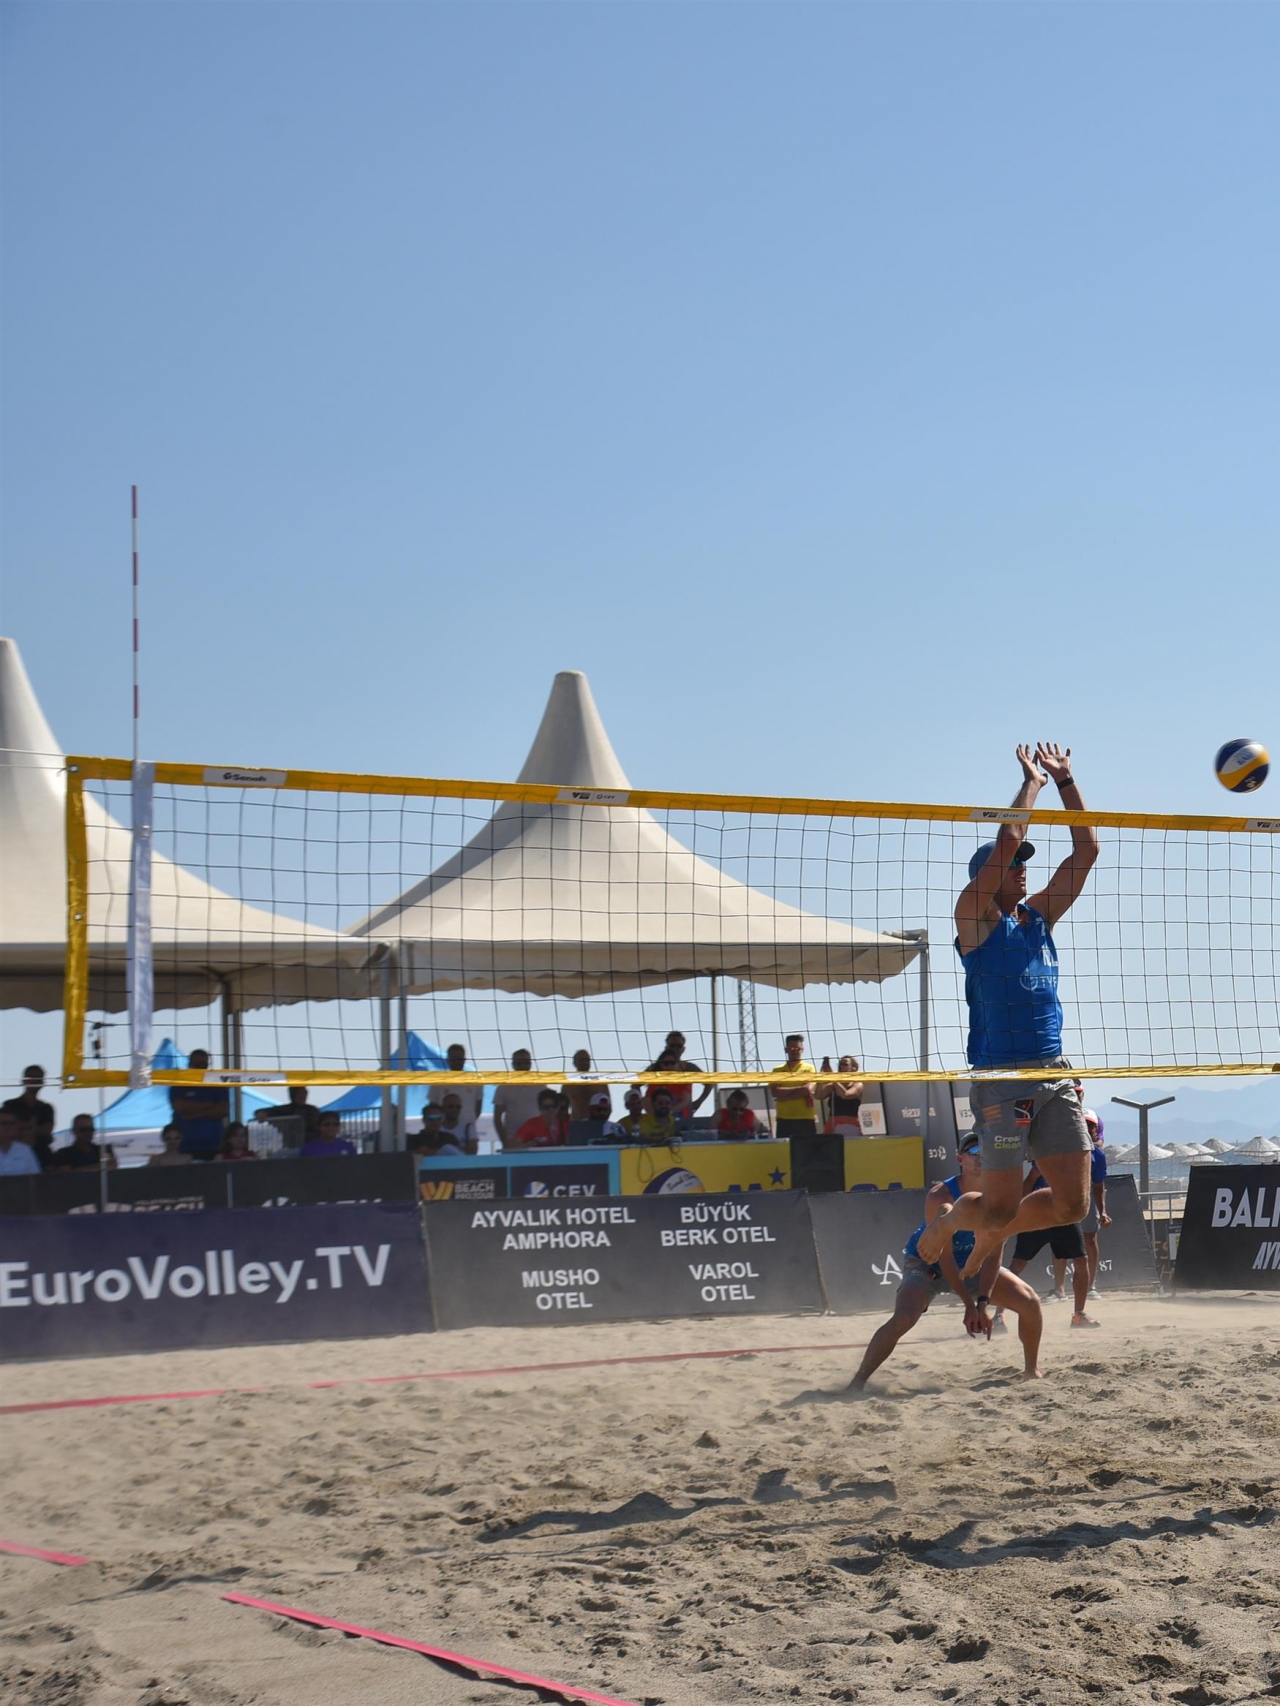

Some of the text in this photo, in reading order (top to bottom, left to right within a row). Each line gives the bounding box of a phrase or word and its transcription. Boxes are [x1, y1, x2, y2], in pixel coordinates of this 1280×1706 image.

[232, 773, 267, 782] Senoh
[454, 1183, 494, 1193] BEACH
[553, 1184, 596, 1198] CEV
[471, 1207, 636, 1228] AYVALIK HOTEL
[680, 1202, 751, 1224] BÜYÜK
[502, 1231, 611, 1250] AMPHORA
[660, 1226, 776, 1247] BERK OTEL
[0, 1244, 391, 1307] EuroVolley.TV
[521, 1268, 600, 1288] MUSHO
[688, 1262, 759, 1281] VAROL
[535, 1292, 593, 1310] OTEL
[700, 1283, 755, 1302] OTEL
